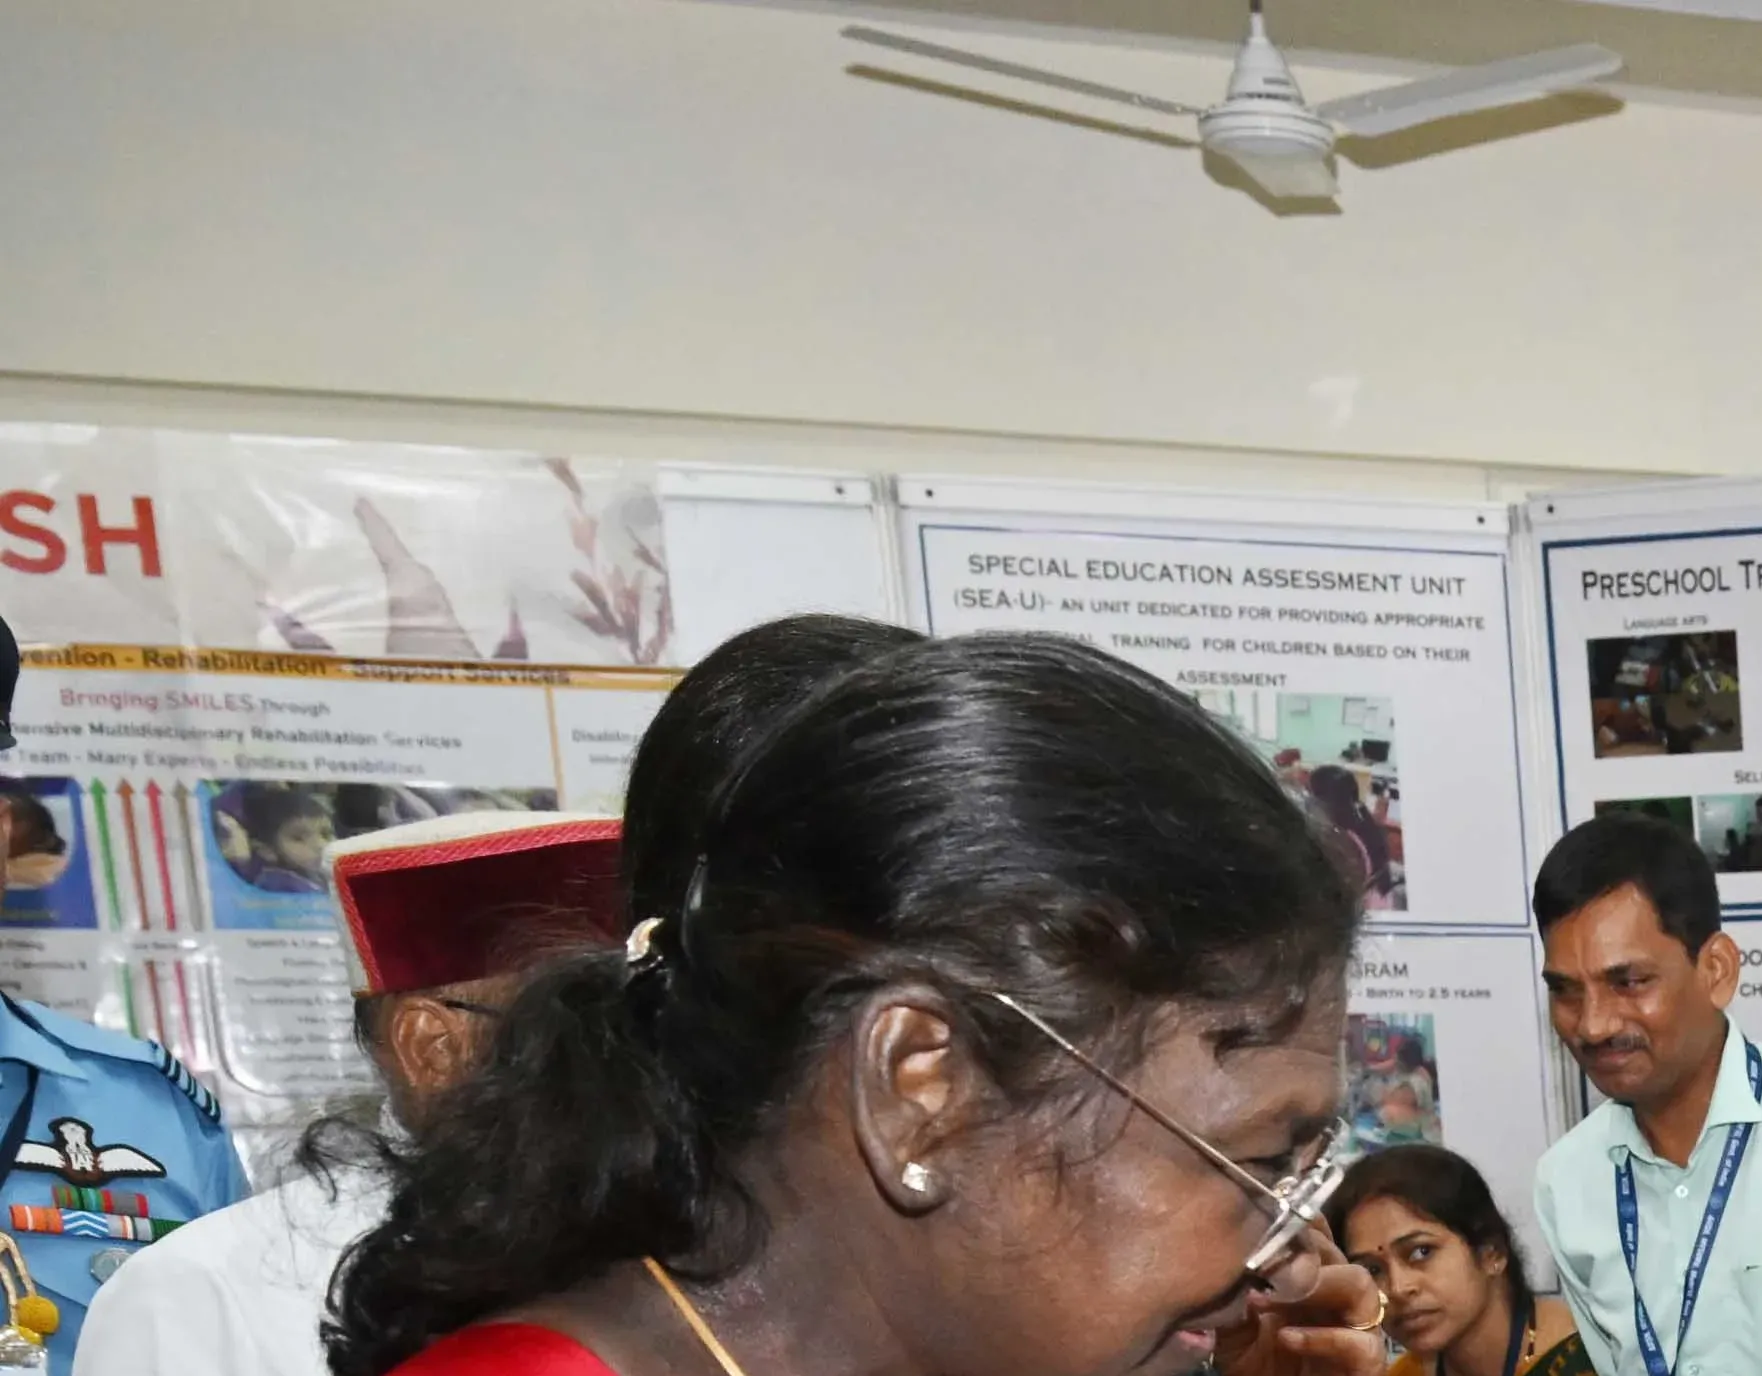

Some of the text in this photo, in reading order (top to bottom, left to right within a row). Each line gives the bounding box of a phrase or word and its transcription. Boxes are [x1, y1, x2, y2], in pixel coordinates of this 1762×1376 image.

[967, 553, 1466, 596] SPECIAL EDUCATION ASSESSMENT UNIT
[1580, 566, 1732, 601] PRESCHOOL
[1060, 598, 1085, 612] AN
[1089, 599, 1131, 614] UNIT
[1136, 601, 1233, 620] DEDICATED
[1237, 605, 1272, 621] FOR
[1277, 607, 1369, 626] PROVIDING
[1373, 612, 1485, 631] APPROPRIATE
[1111, 633, 1191, 651] TRAINING
[1202, 637, 1237, 653] FOR
[1241, 639, 1328, 657] CHILDREN
[1332, 642, 1389, 659] BASED
[1391, 645, 1418, 660] ON
[1423, 646, 1471, 662] THEIR
[142, 651, 327, 676] Rehabilitation
[1176, 669, 1287, 687] ASSESSMENT
